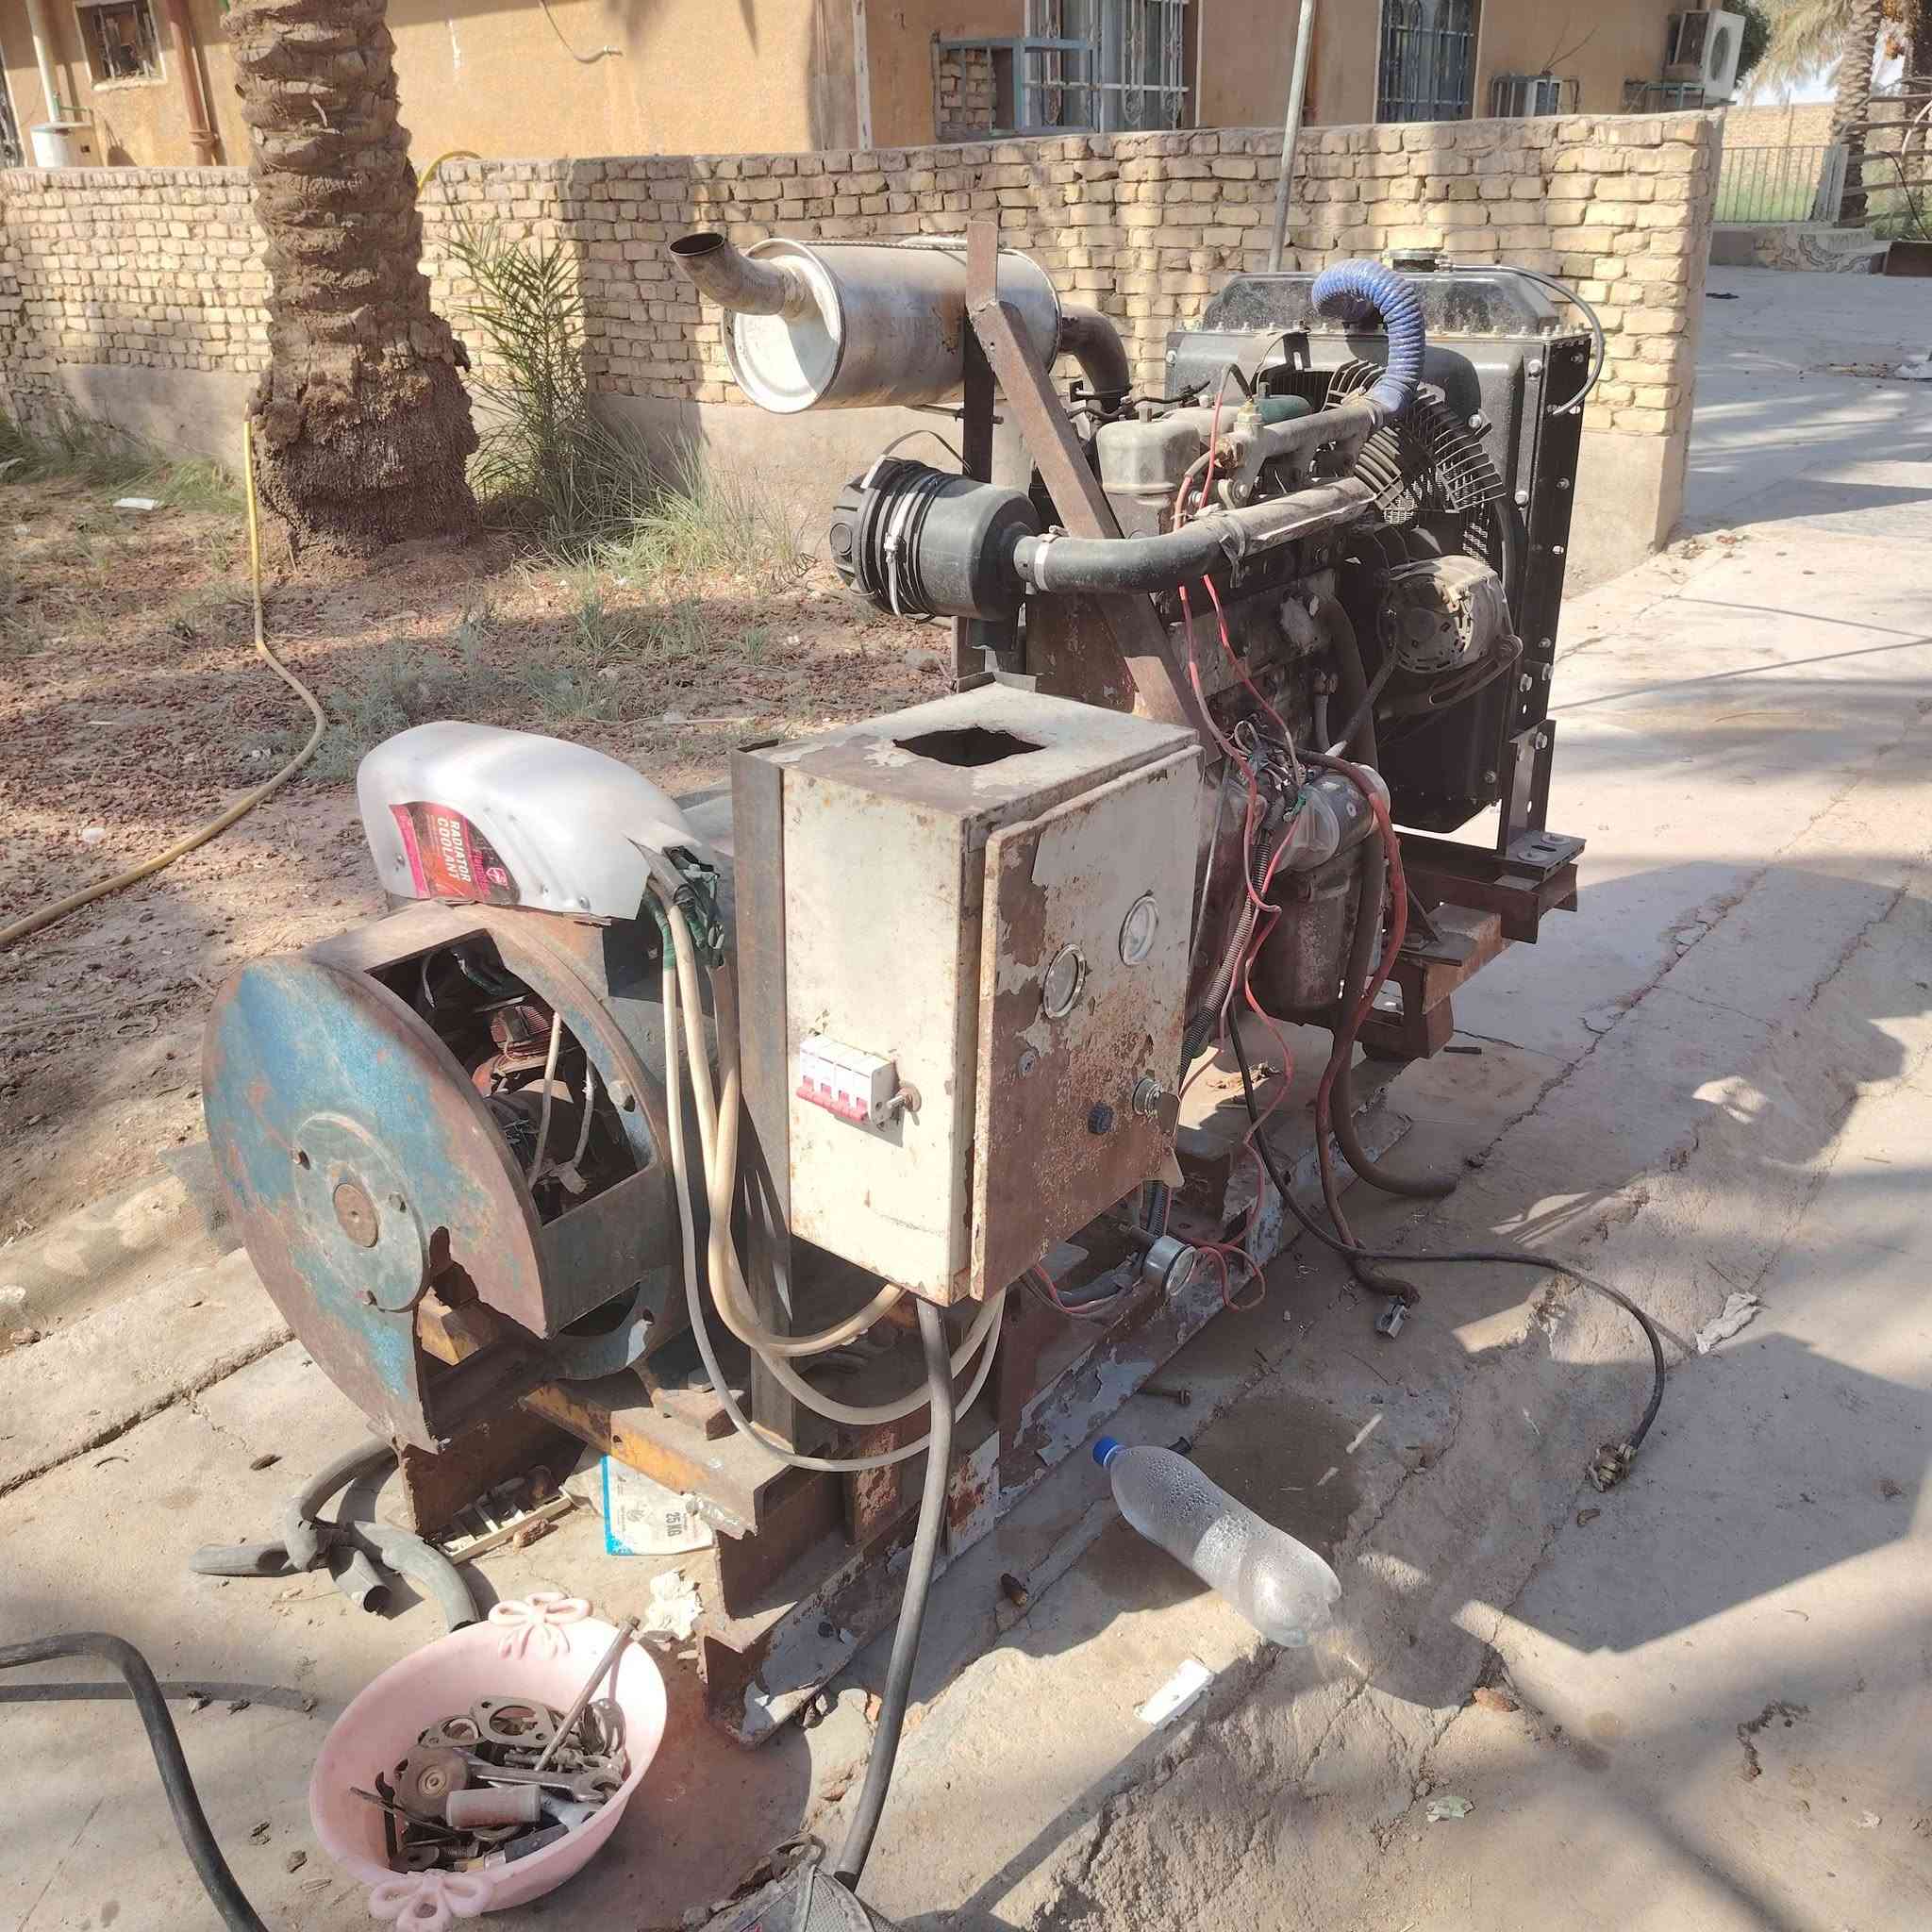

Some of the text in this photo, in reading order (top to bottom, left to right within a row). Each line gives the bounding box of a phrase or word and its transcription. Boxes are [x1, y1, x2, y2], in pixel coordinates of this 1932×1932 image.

[437, 817, 461, 879] COOLANT
[451, 821, 472, 883] RADIATOR
[665, 1511, 682, 1537] 25 KG
